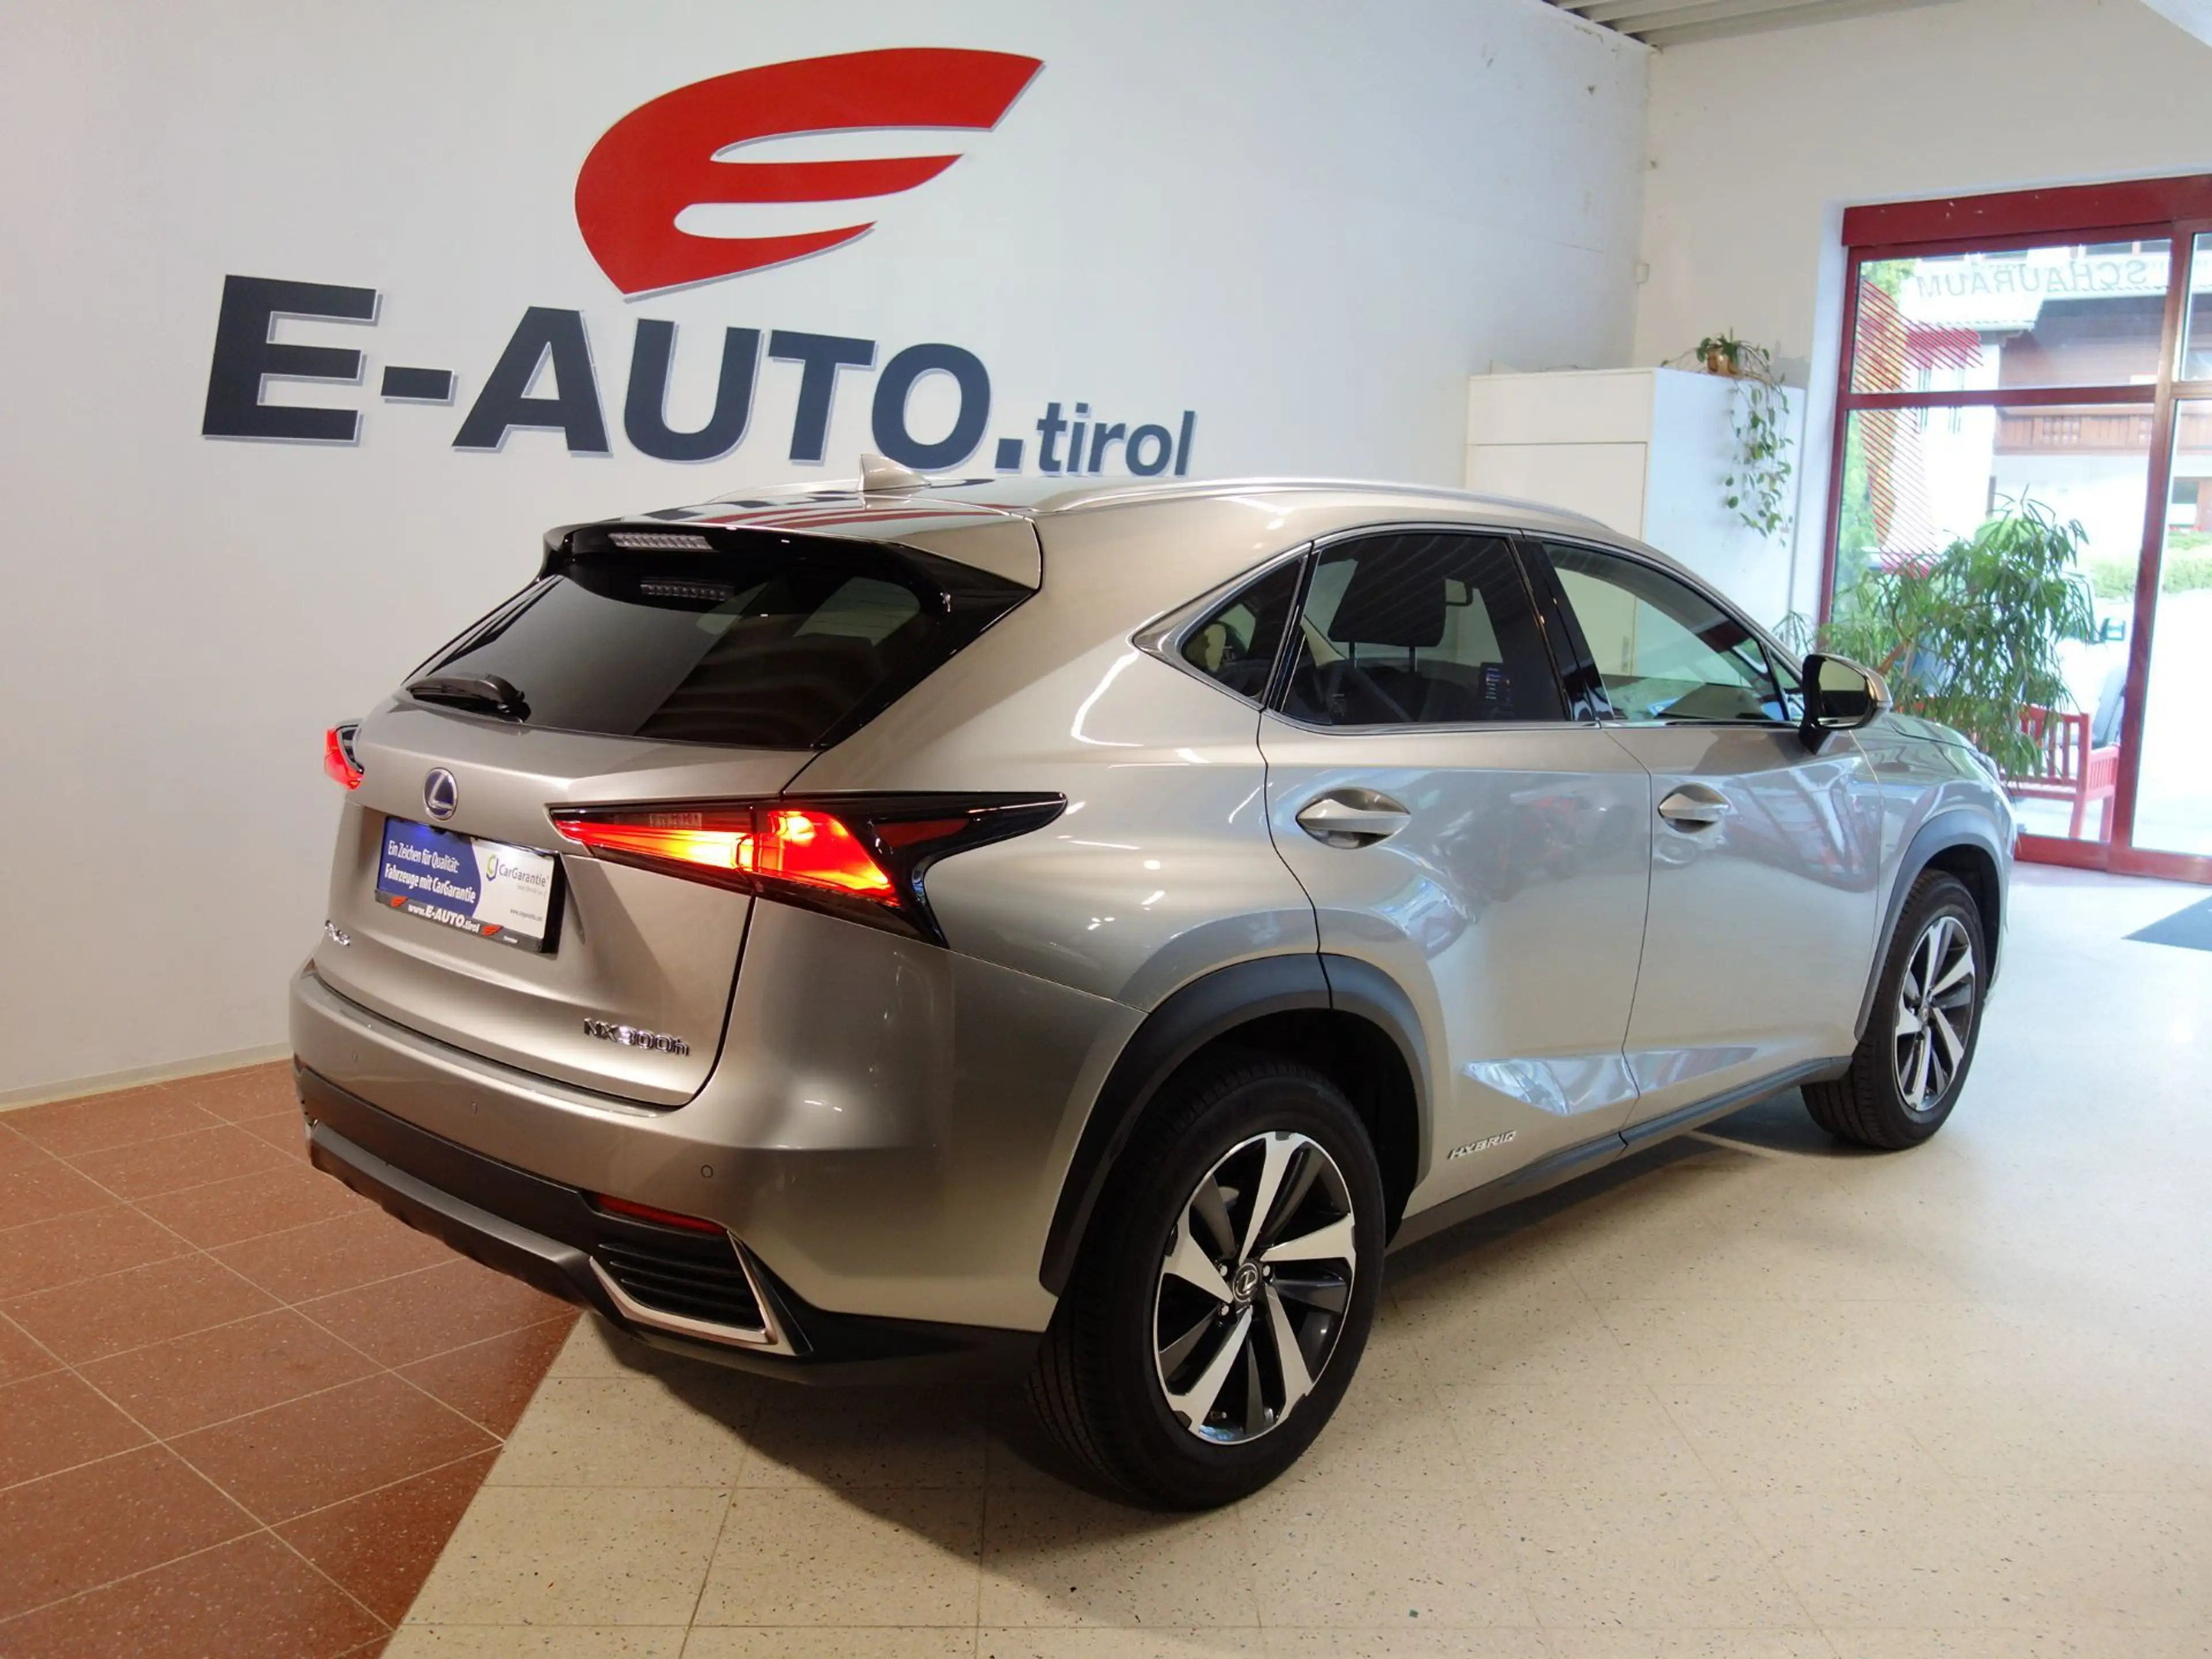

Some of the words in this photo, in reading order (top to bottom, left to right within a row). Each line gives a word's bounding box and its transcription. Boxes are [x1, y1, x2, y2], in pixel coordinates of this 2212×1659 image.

[388, 839, 399, 857] Ein
[398, 843, 421, 863] Zeichen
[421, 849, 432, 865] für
[384, 863, 419, 889] Fahrzeuge
[419, 874, 433, 892] mit
[432, 877, 476, 904] CarGarantie
[499, 864, 547, 887] CarGarantie
[407, 904, 480, 933] www.E-AUTO.tirol
[1447, 1130, 1517, 1161] HYBRID
